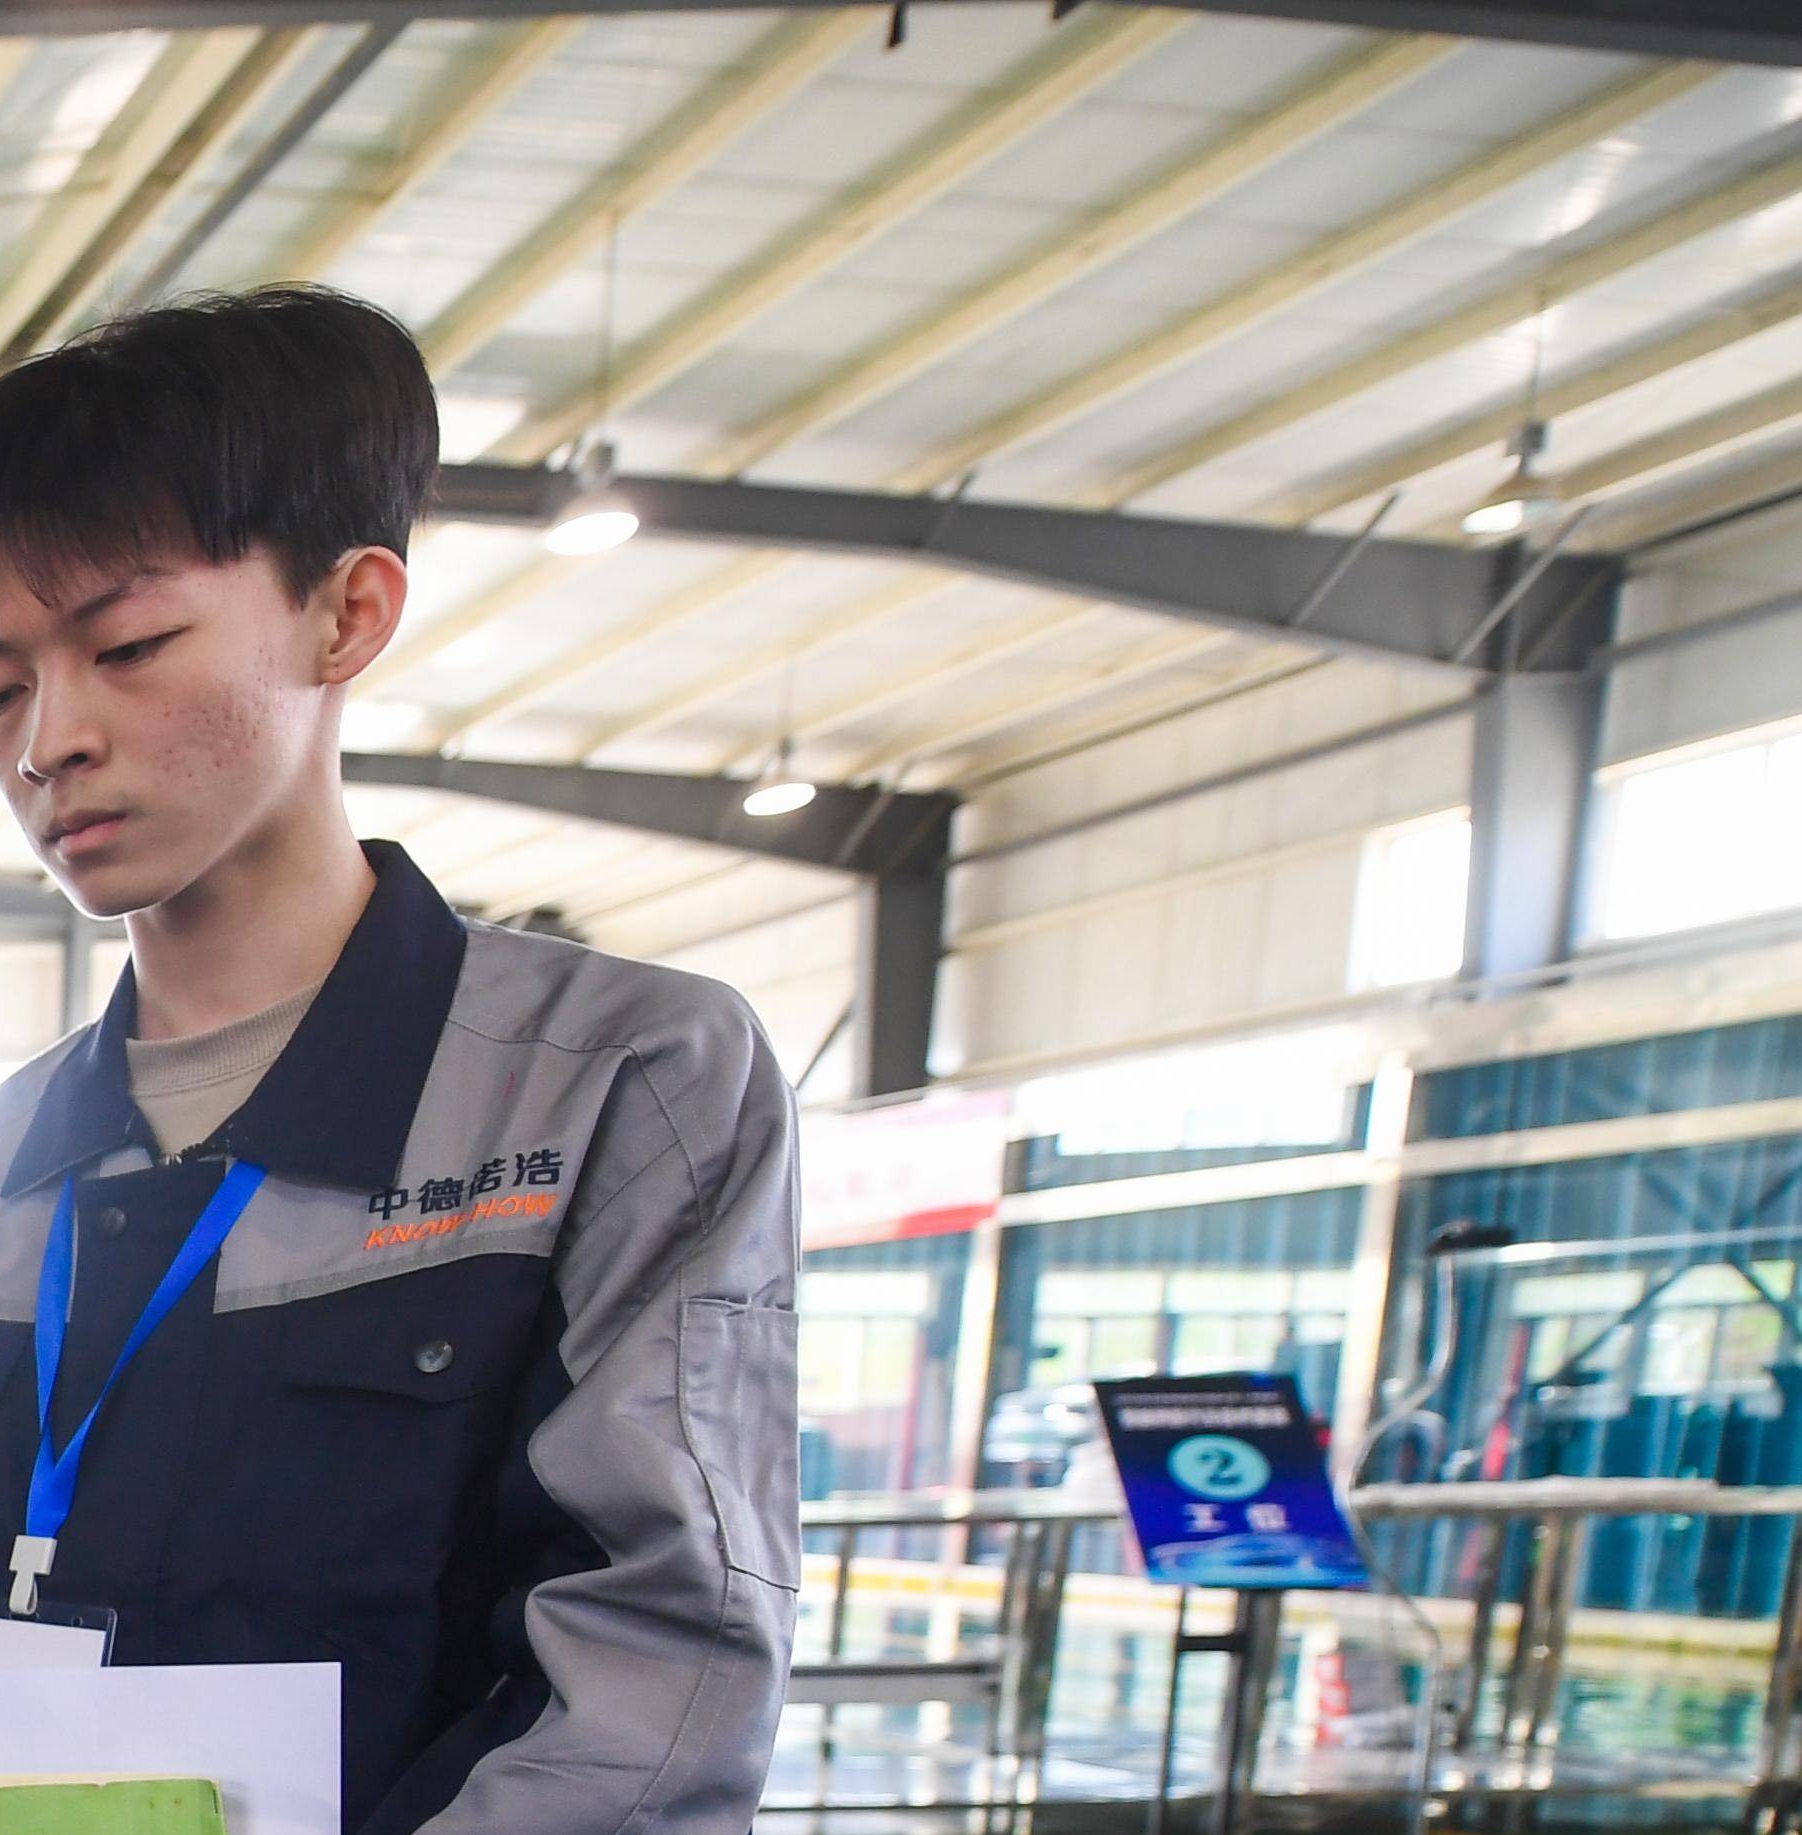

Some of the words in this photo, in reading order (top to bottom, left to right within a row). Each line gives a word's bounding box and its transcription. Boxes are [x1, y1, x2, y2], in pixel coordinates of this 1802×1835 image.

[368, 1148, 564, 1221] 中德诺浩
[1198, 1447, 1244, 1486] 2
